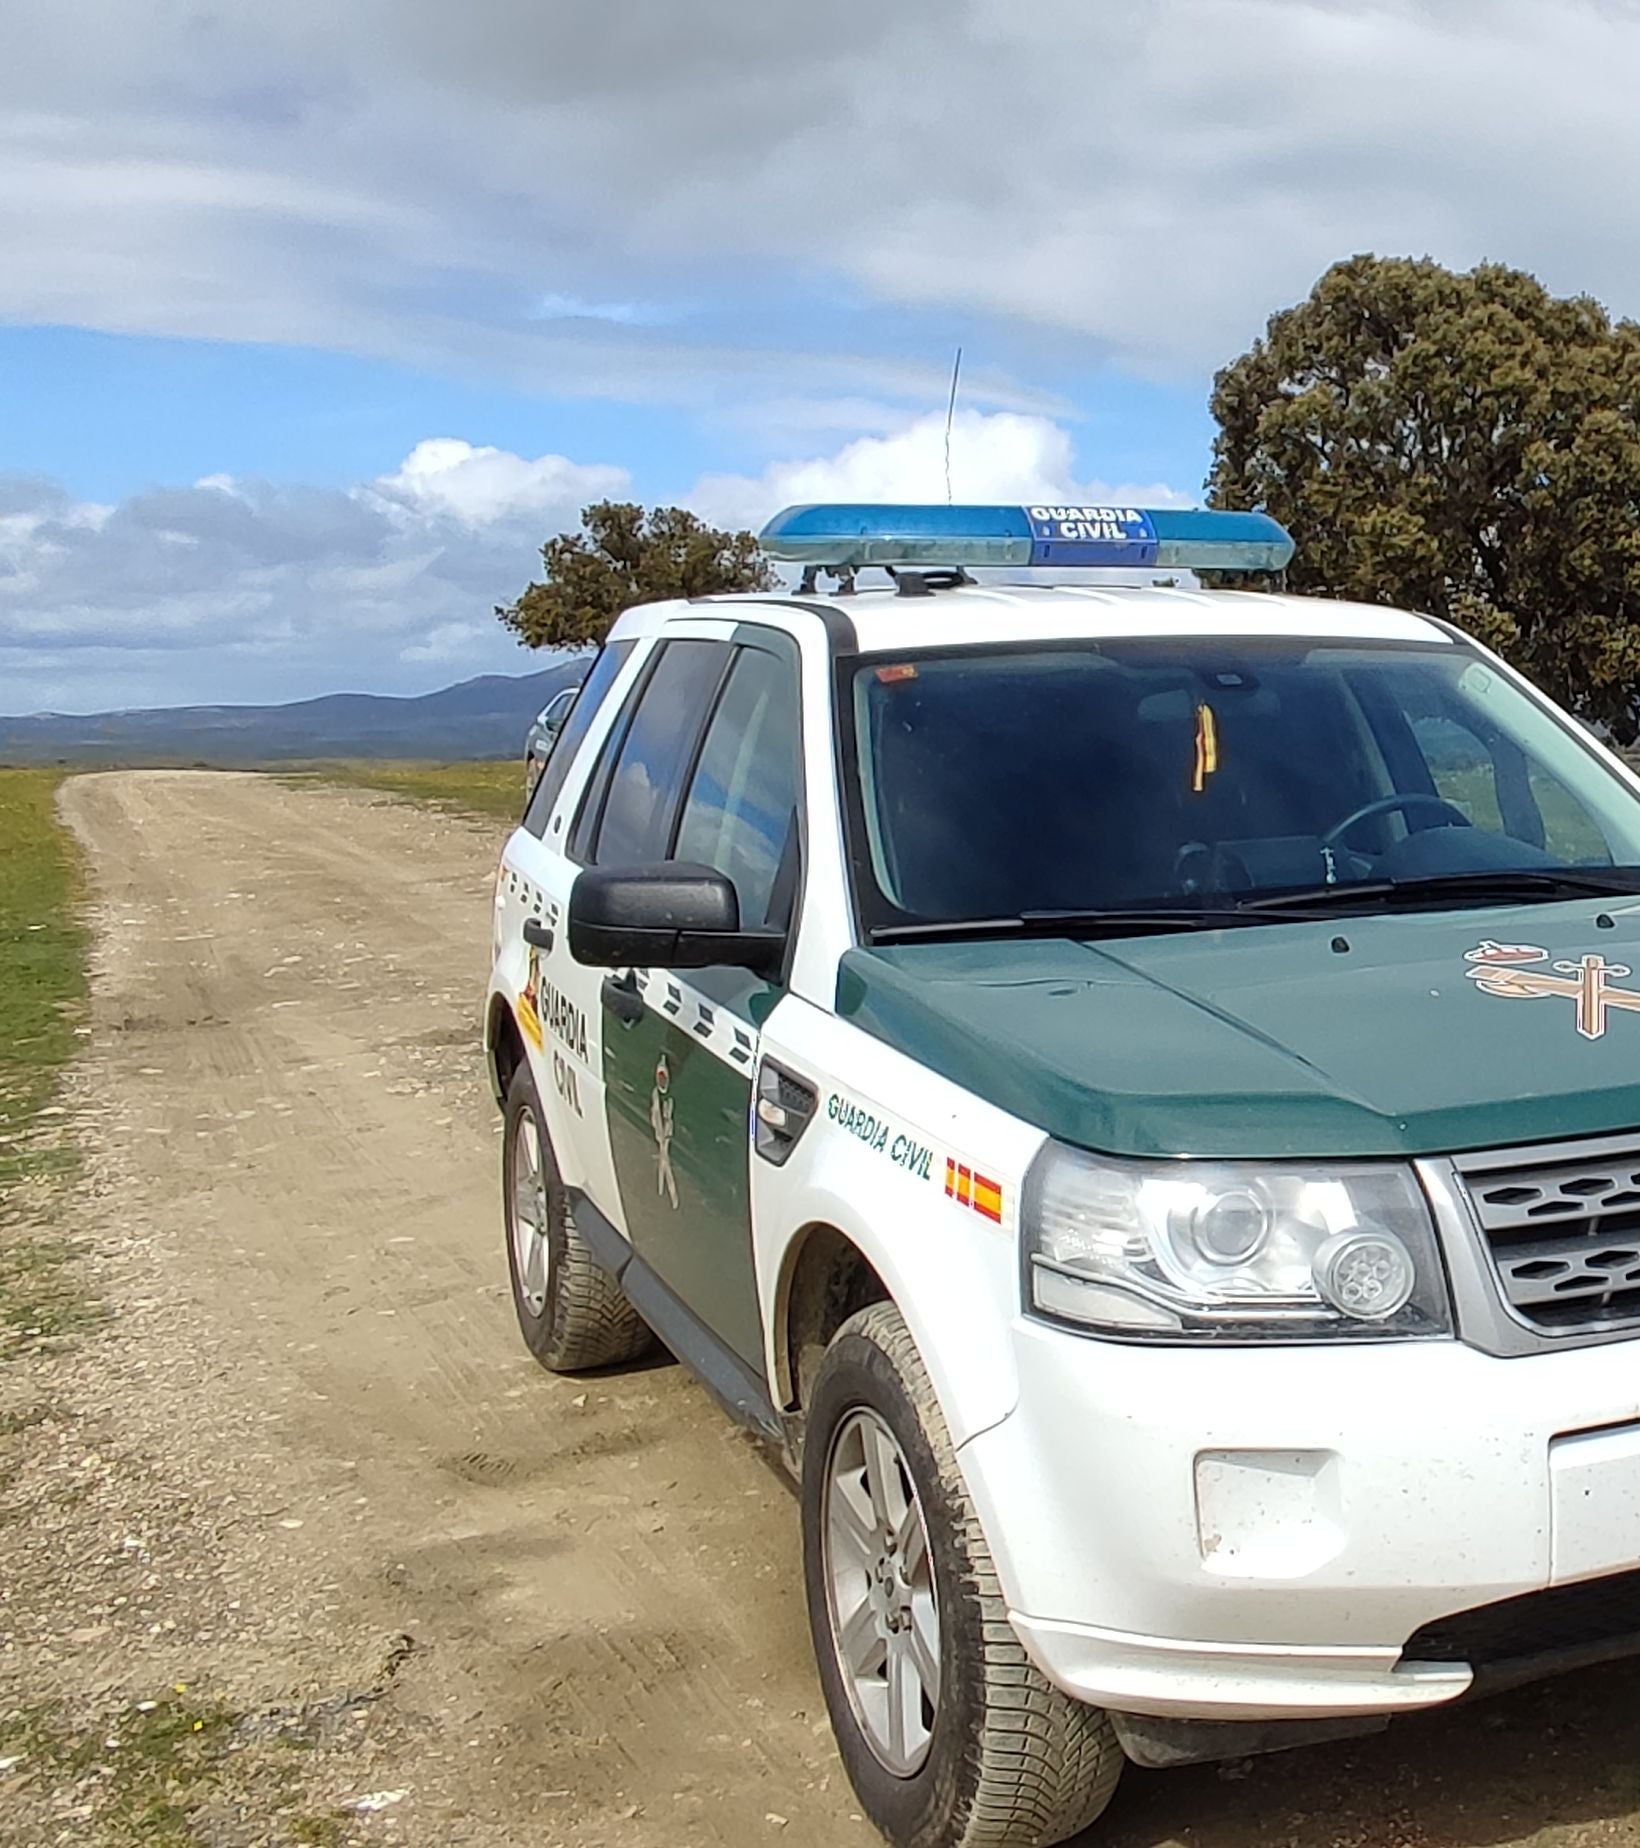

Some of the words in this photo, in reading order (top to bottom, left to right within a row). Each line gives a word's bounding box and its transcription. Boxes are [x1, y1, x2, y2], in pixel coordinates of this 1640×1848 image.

[1030, 506, 1143, 523] GUARDIA
[1060, 521, 1127, 540] CIVIL
[540, 975, 589, 1065] GUARDIA
[554, 1049, 584, 1120] CIVIL
[828, 1093, 890, 1152] GUARDIA
[890, 1134, 934, 1181] CIVIL
